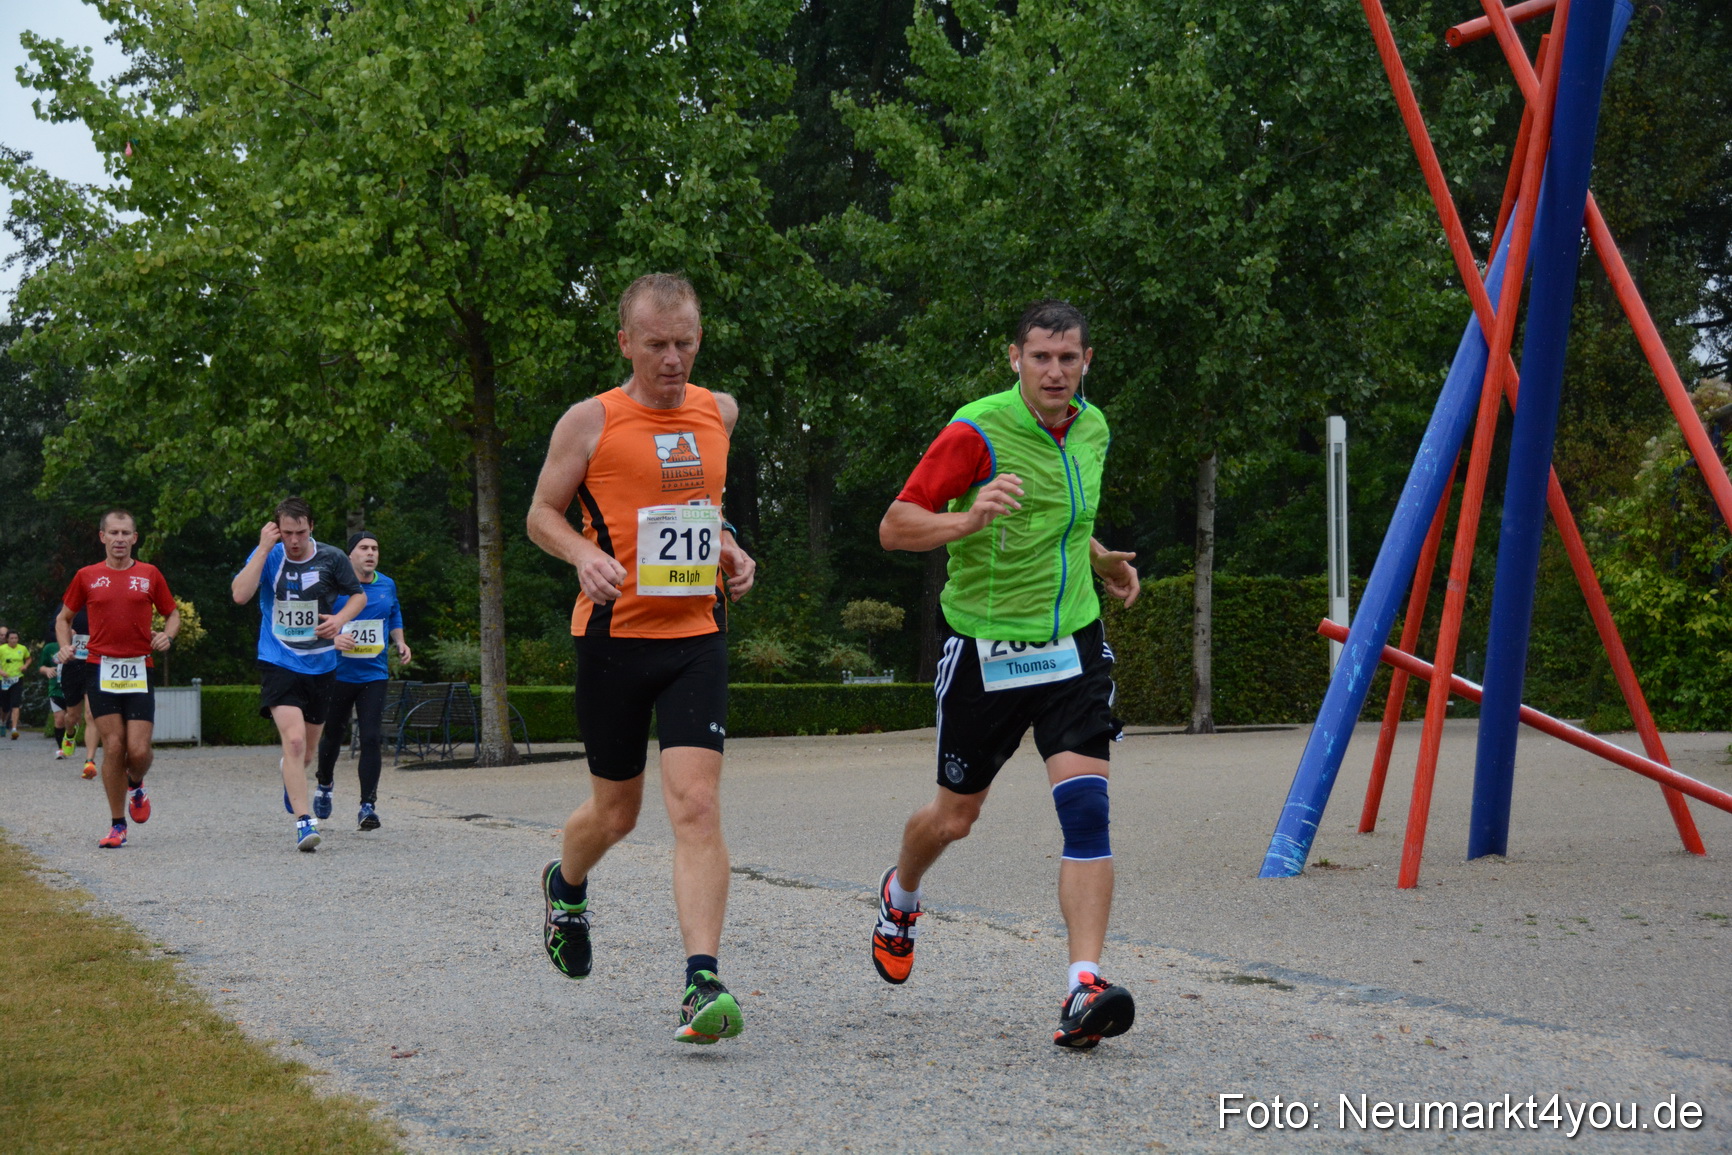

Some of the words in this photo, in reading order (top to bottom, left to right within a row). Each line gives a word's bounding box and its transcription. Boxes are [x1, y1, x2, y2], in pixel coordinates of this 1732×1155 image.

[662, 467, 704, 479] HIRSCH
[659, 527, 711, 561] 218
[669, 570, 700, 585] Ralph
[278, 610, 314, 626] 2138
[351, 629, 376, 643] 245
[111, 664, 138, 679] 204
[1006, 659, 1057, 675] Thomas
